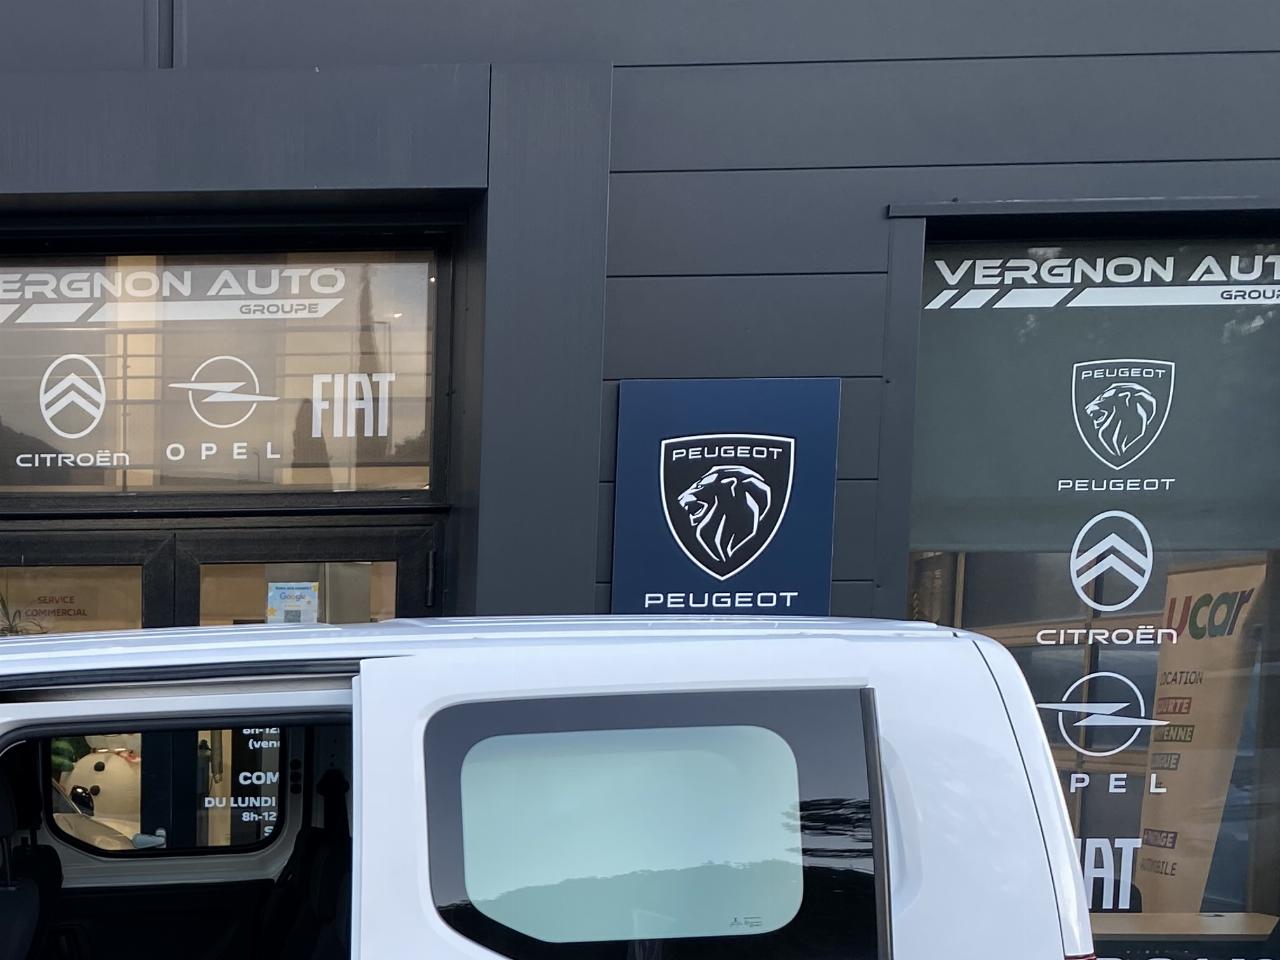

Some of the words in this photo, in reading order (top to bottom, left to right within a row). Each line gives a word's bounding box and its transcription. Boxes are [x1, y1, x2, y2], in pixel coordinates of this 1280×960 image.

[934, 256, 1175, 285] VERGNON
[1187, 254, 1280, 281] AUT
[206, 268, 346, 297] AUTO
[1220, 289, 1280, 301] GROU
[239, 302, 319, 315] GROUPE
[1081, 367, 1166, 380] PEUGEOT
[311, 372, 396, 438] FIAT
[166, 441, 281, 461] OPEL
[672, 445, 783, 461] PEUGEOT
[1057, 478, 1176, 491] PEUGEOT
[37, 595, 76, 605] SERVICE
[644, 592, 799, 608] PEUGEOT
[24, 608, 88, 617] COMMERCIAL
[238, 771, 280, 785] COM
[1069, 773, 1168, 793] PEL
[204, 796, 226, 808] DU
[229, 796, 276, 808] LUNDI
[241, 811, 277, 822] 8h-12
[1075, 838, 1143, 909] AT
